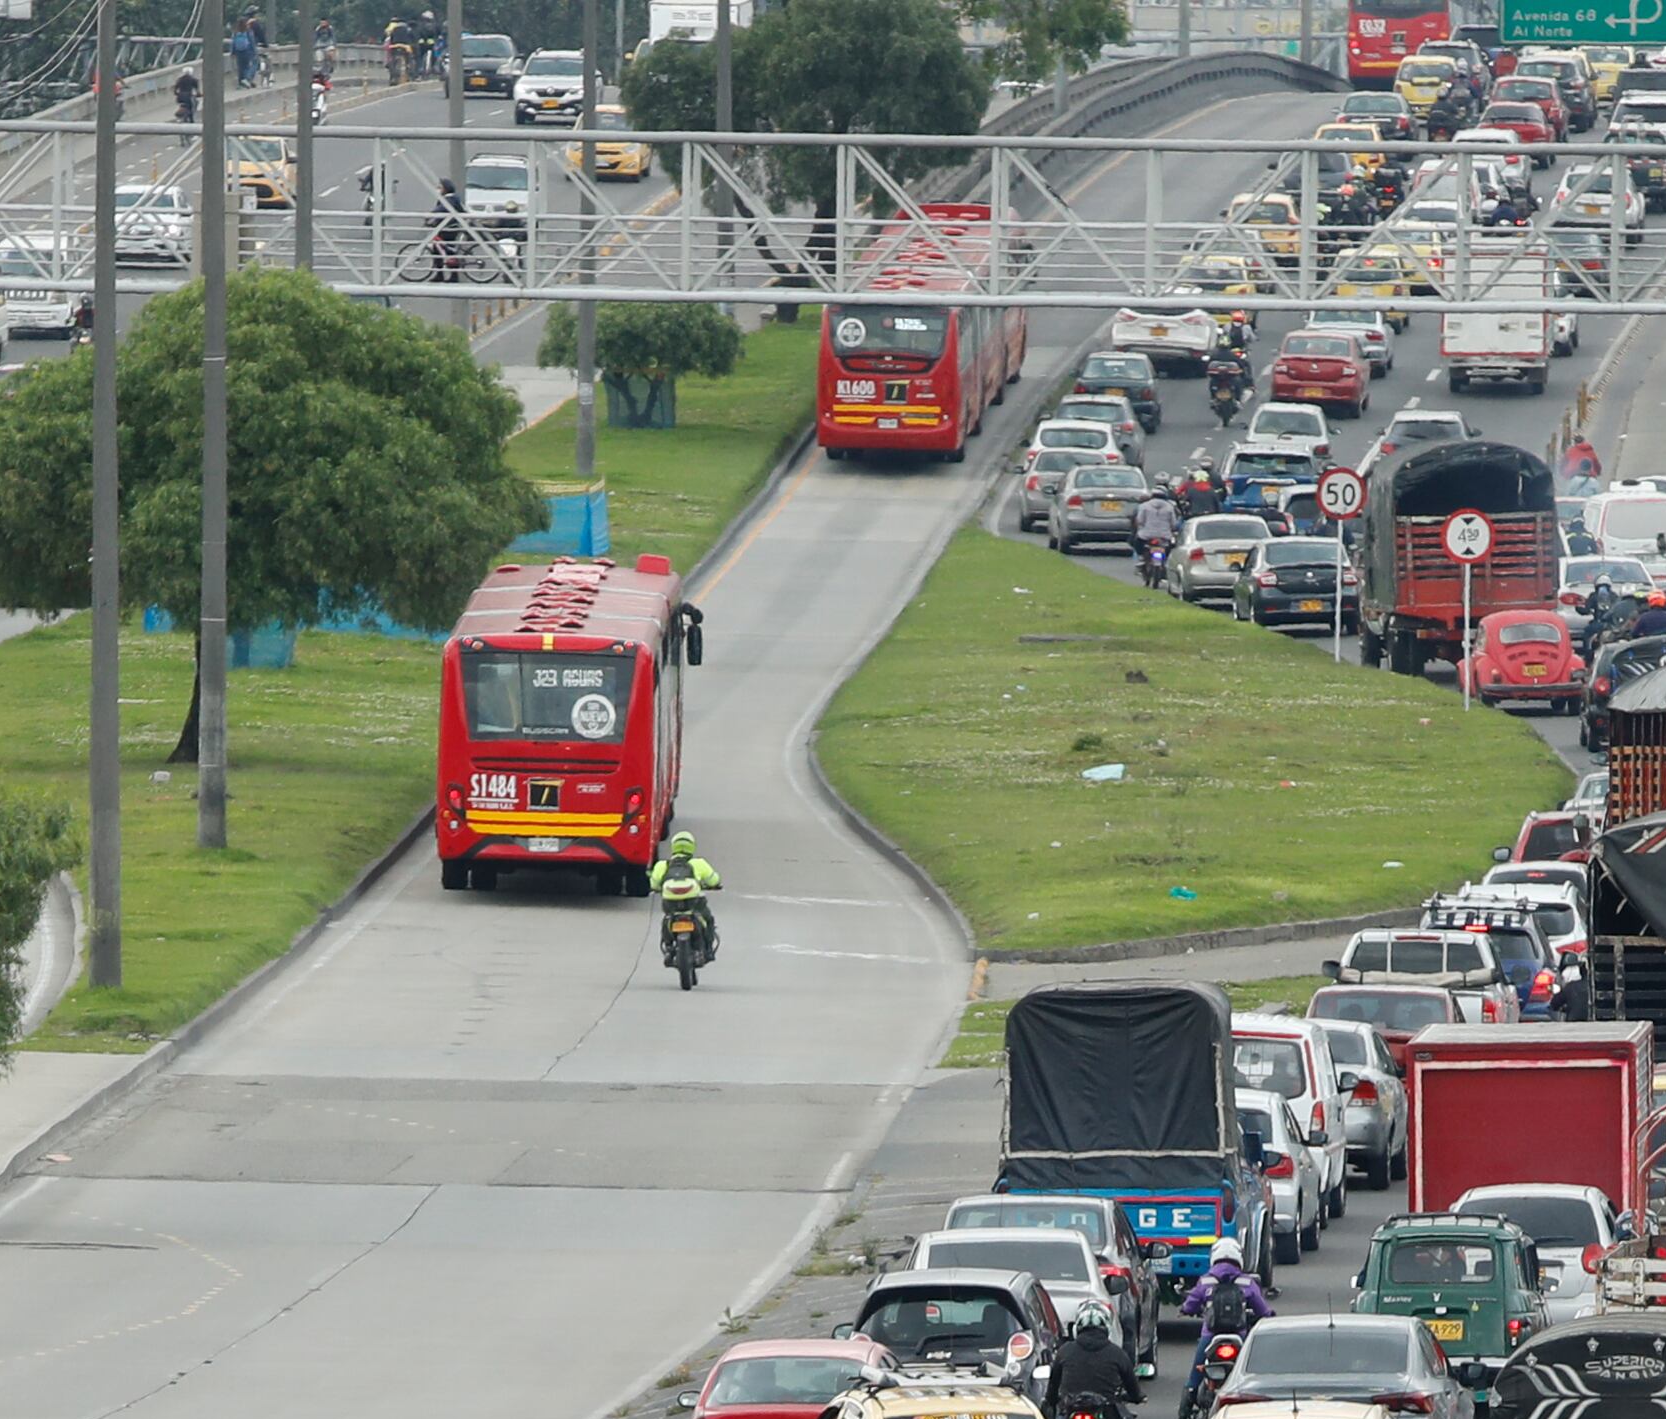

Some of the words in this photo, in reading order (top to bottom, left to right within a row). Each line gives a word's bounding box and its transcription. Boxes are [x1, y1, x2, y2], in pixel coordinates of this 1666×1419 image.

[1512, 10, 1569, 22] Avenida
[1575, 10, 1597, 21] 68
[1512, 26, 1528, 37] Al
[1534, 26, 1572, 38] Norte
[837, 380, 875, 394] K1600
[1326, 483, 1356, 506] 50
[470, 774, 516, 798] S1484
